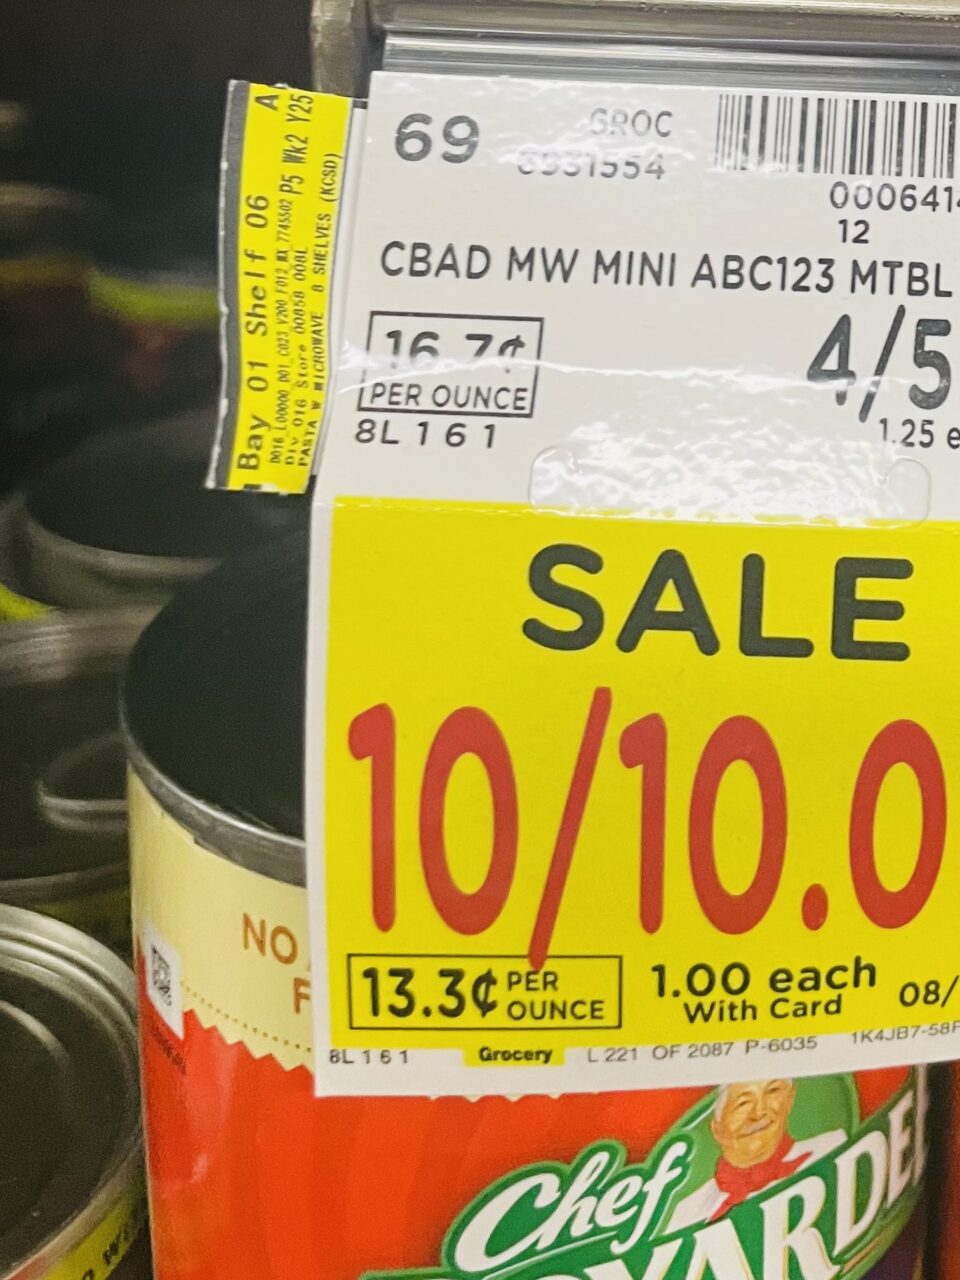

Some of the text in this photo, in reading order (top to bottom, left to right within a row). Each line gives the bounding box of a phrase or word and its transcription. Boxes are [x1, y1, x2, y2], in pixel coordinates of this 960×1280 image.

[287, 94, 313, 121] Y25
[589, 107, 673, 138] GROC
[282, 135, 308, 163] Wk2
[394, 113, 480, 164] 69
[279, 175, 303, 194] P5
[320, 153, 342, 202] (KCSD)
[313, 213, 330, 274] SHELVES
[837, 218, 870, 245] 12
[237, 95, 279, 470] Bay 01 Shelf 06 A
[380, 240, 492, 279] CBAD
[507, 246, 580, 283] MW
[592, 249, 676, 287] MINI
[691, 253, 835, 294] ABC123
[850, 259, 953, 299] MTBL
[298, 344, 308, 388] Store
[311, 312, 324, 391] MICROWAVE
[385, 330, 526, 374] 167¢
[293, 399, 306, 427] 016
[369, 382, 528, 411] PER OUNCE
[298, 420, 317, 466] PASTA
[879, 418, 935, 448] 1.25
[522, 541, 915, 662] SALE
[243, 913, 299, 965] NO
[362, 967, 559, 1018] 13.3¢ PER
[651, 955, 877, 999] 1.00 each
[507, 999, 605, 1021] OUNCE
[683, 993, 842, 1024] With Card
[478, 1046, 554, 1065] Grocery
[604, 1047, 639, 1062] 221
[652, 1044, 682, 1061] OF
[687, 1041, 735, 1059] 2087
[744, 1036, 818, 1056] P-6035
[453, 1140, 689, 1273] Chef
